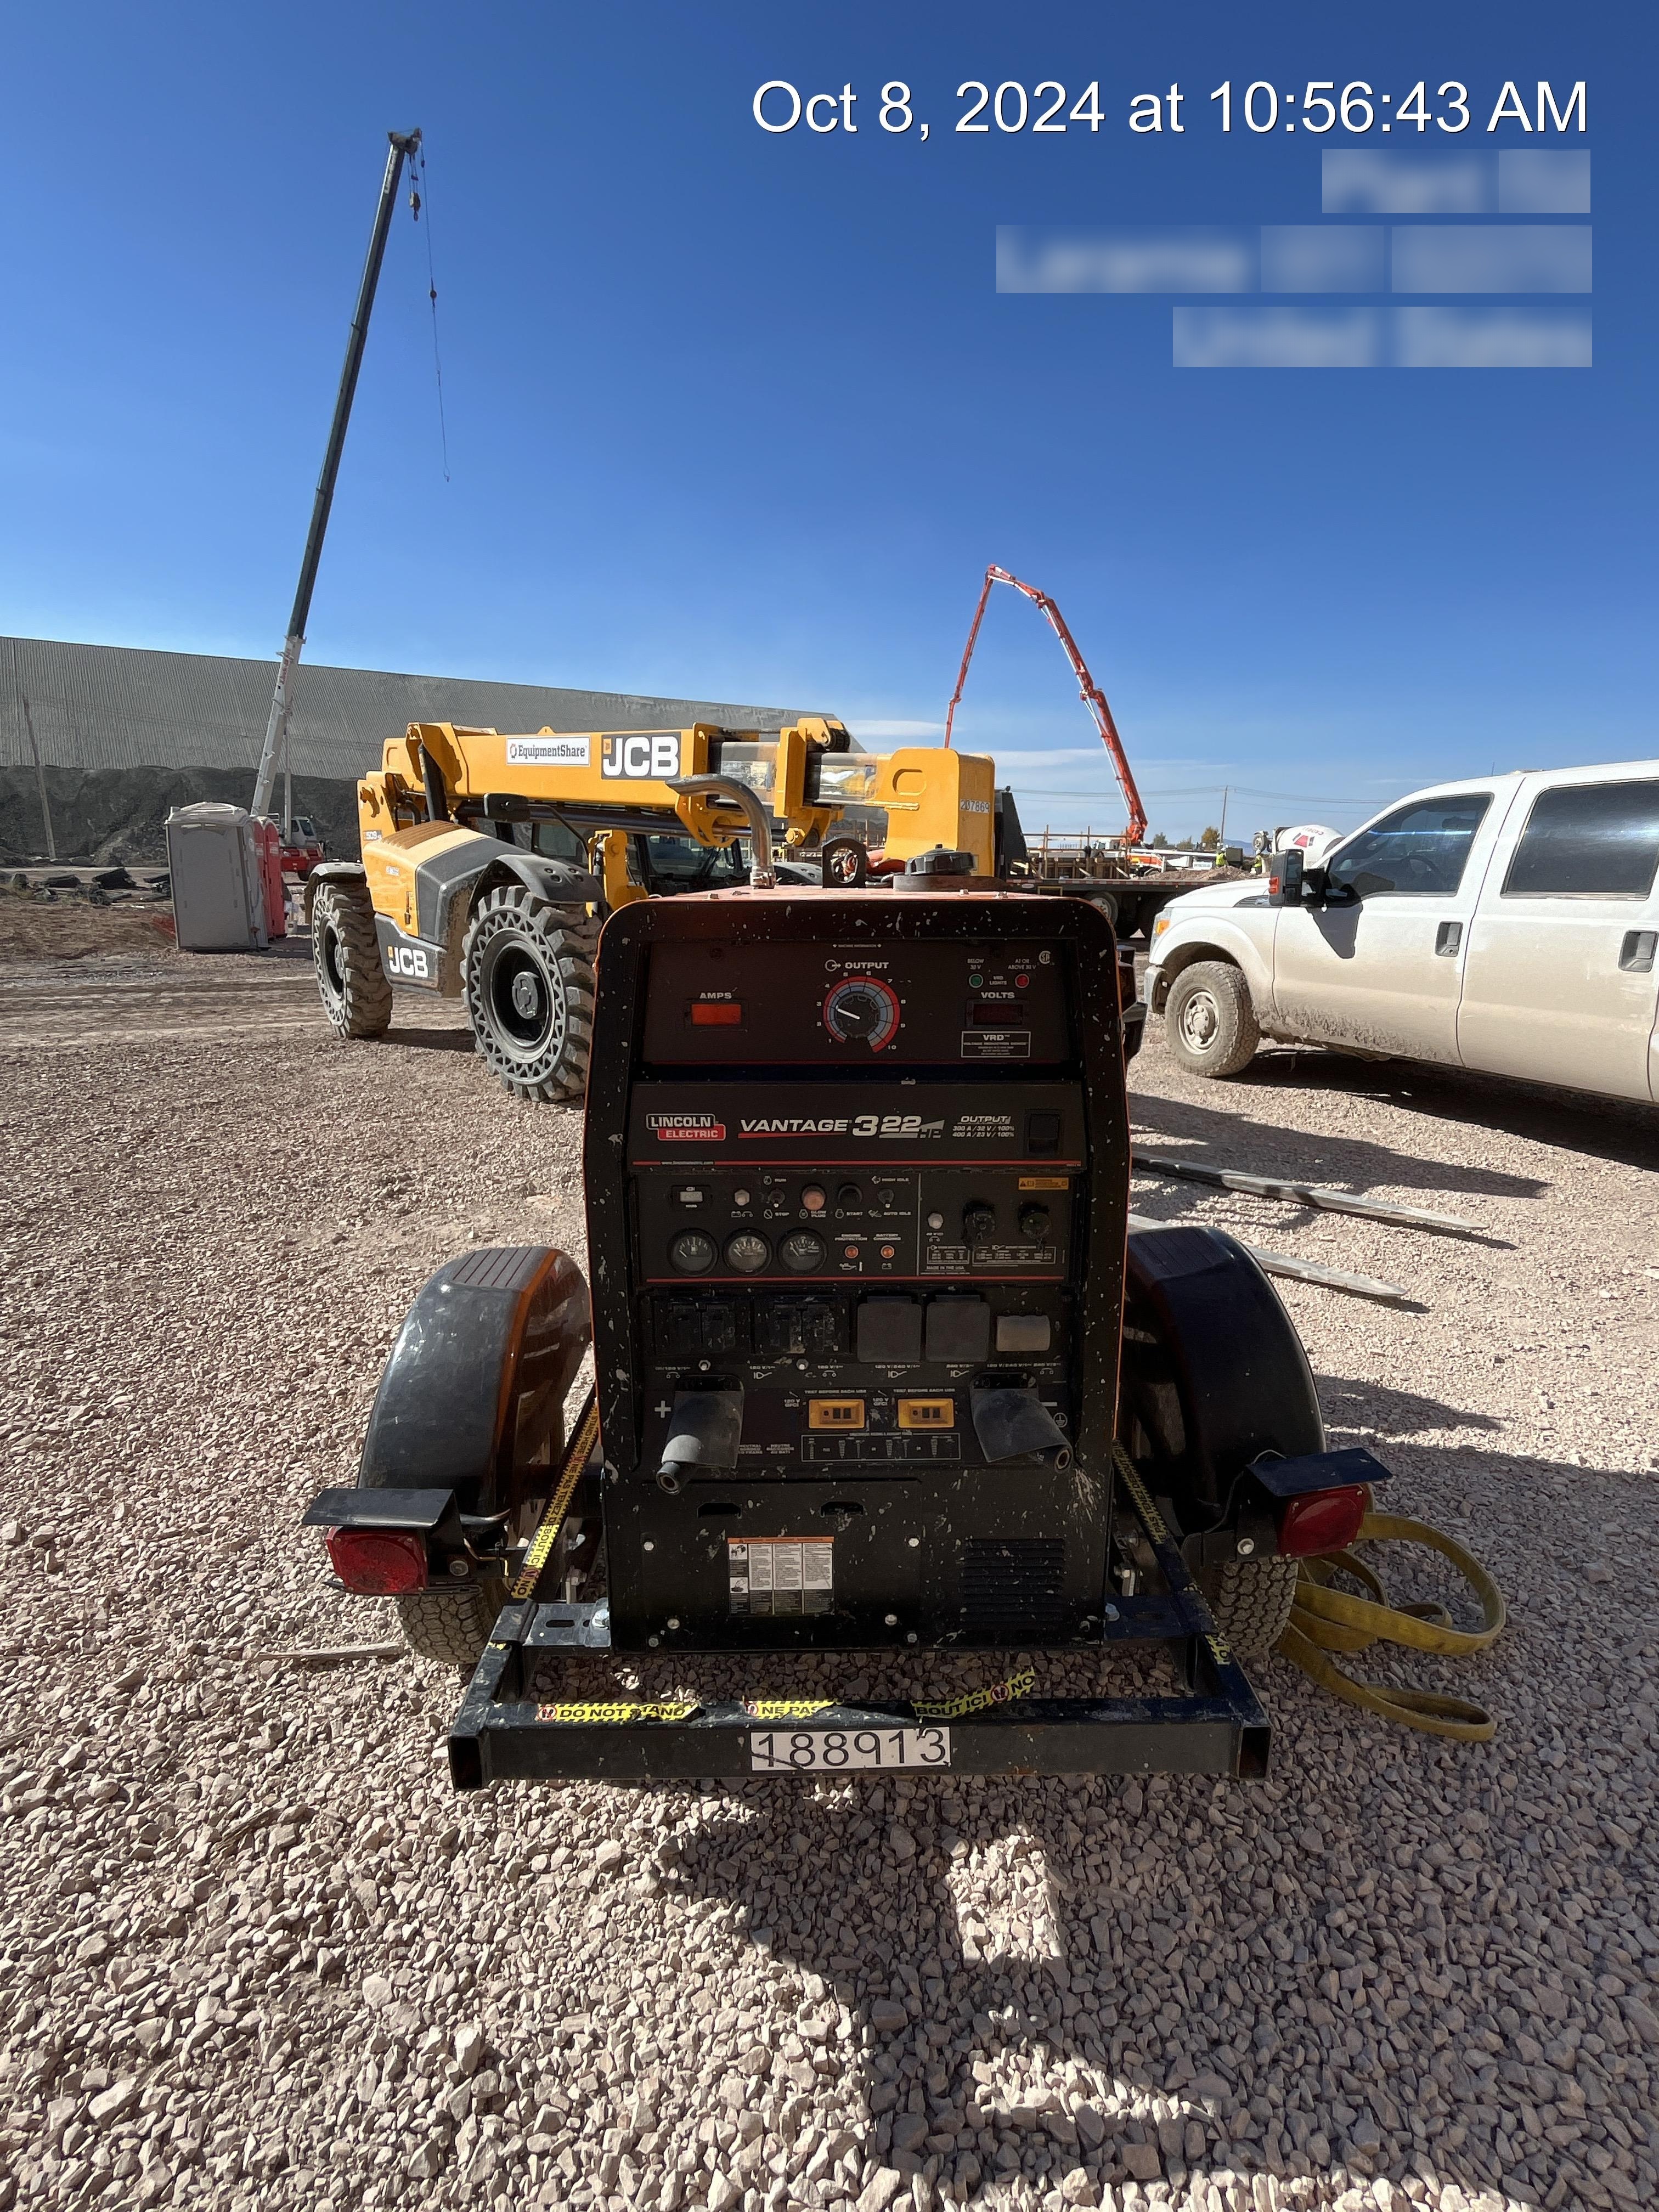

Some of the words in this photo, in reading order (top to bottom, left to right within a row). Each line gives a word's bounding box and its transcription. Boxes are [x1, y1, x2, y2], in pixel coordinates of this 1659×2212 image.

[518, 744, 585, 760] EquipmentShare
[603, 736, 679, 777] JCB
[961, 799, 990, 813] 207869
[388, 946, 429, 978] JCB
[844, 961, 890, 970] OUTPUT
[651, 1116, 712, 1127] LINCOLN
[741, 1119, 849, 1132] VANTAGE
[851, 1115, 922, 1137] 322
[665, 1130, 719, 1138] ELECTRIC
[563, 1474, 573, 1489] PAS
[551, 1488, 568, 1515] TENEZ
[966, 1694, 988, 1709] ICI
[560, 1709, 586, 1718] DO
[589, 1708, 626, 1717] NOT
[762, 1706, 784, 1716] NE
[758, 1728, 947, 1768] 188913
